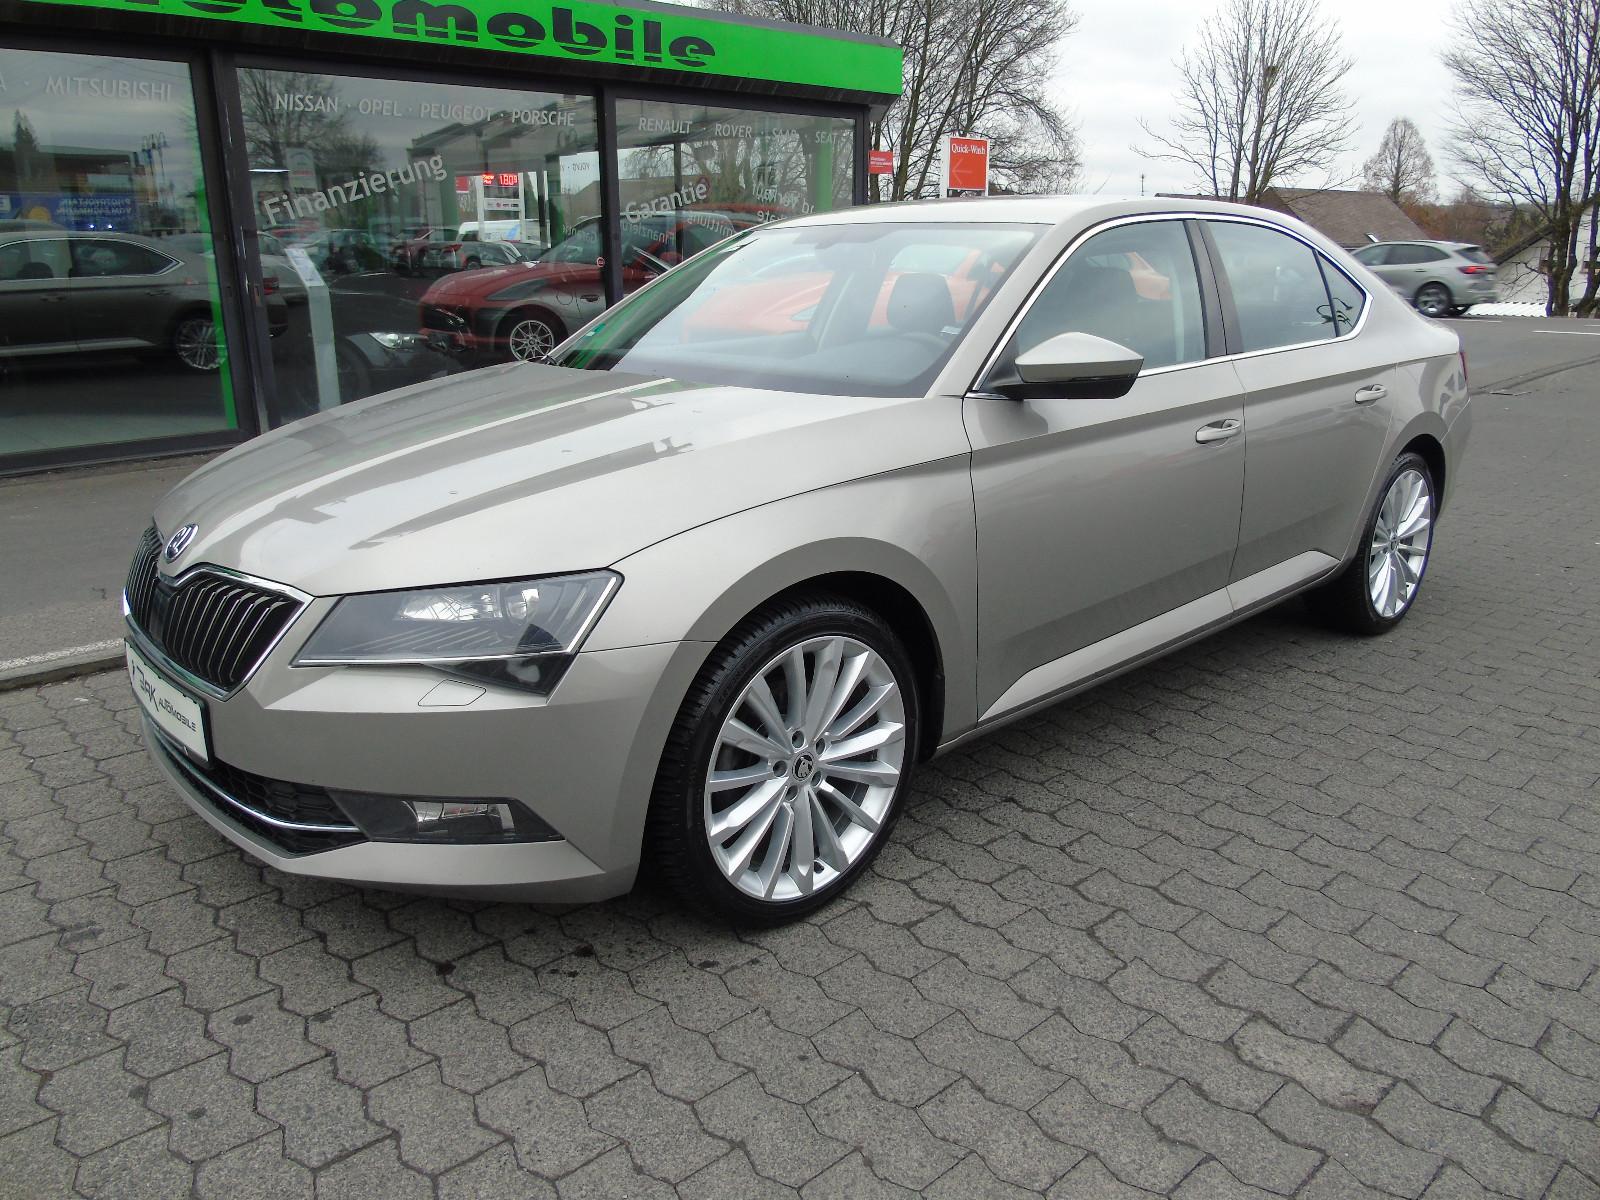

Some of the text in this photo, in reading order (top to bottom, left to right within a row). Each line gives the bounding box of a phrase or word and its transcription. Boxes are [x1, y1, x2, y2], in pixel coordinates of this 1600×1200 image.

[124, 0, 716, 67] omobile
[45, 75, 172, 101] MITSUBISHI
[274, 92, 575, 127] NISSAN OPEL PEUGEOT PORSCHE
[638, 117, 692, 134] RENAULT
[715, 123, 752, 138] ROVER
[951, 143, 986, 155] Quick-Wash
[264, 154, 447, 225] Finanzierung
[625, 180, 707, 223] Garantie
